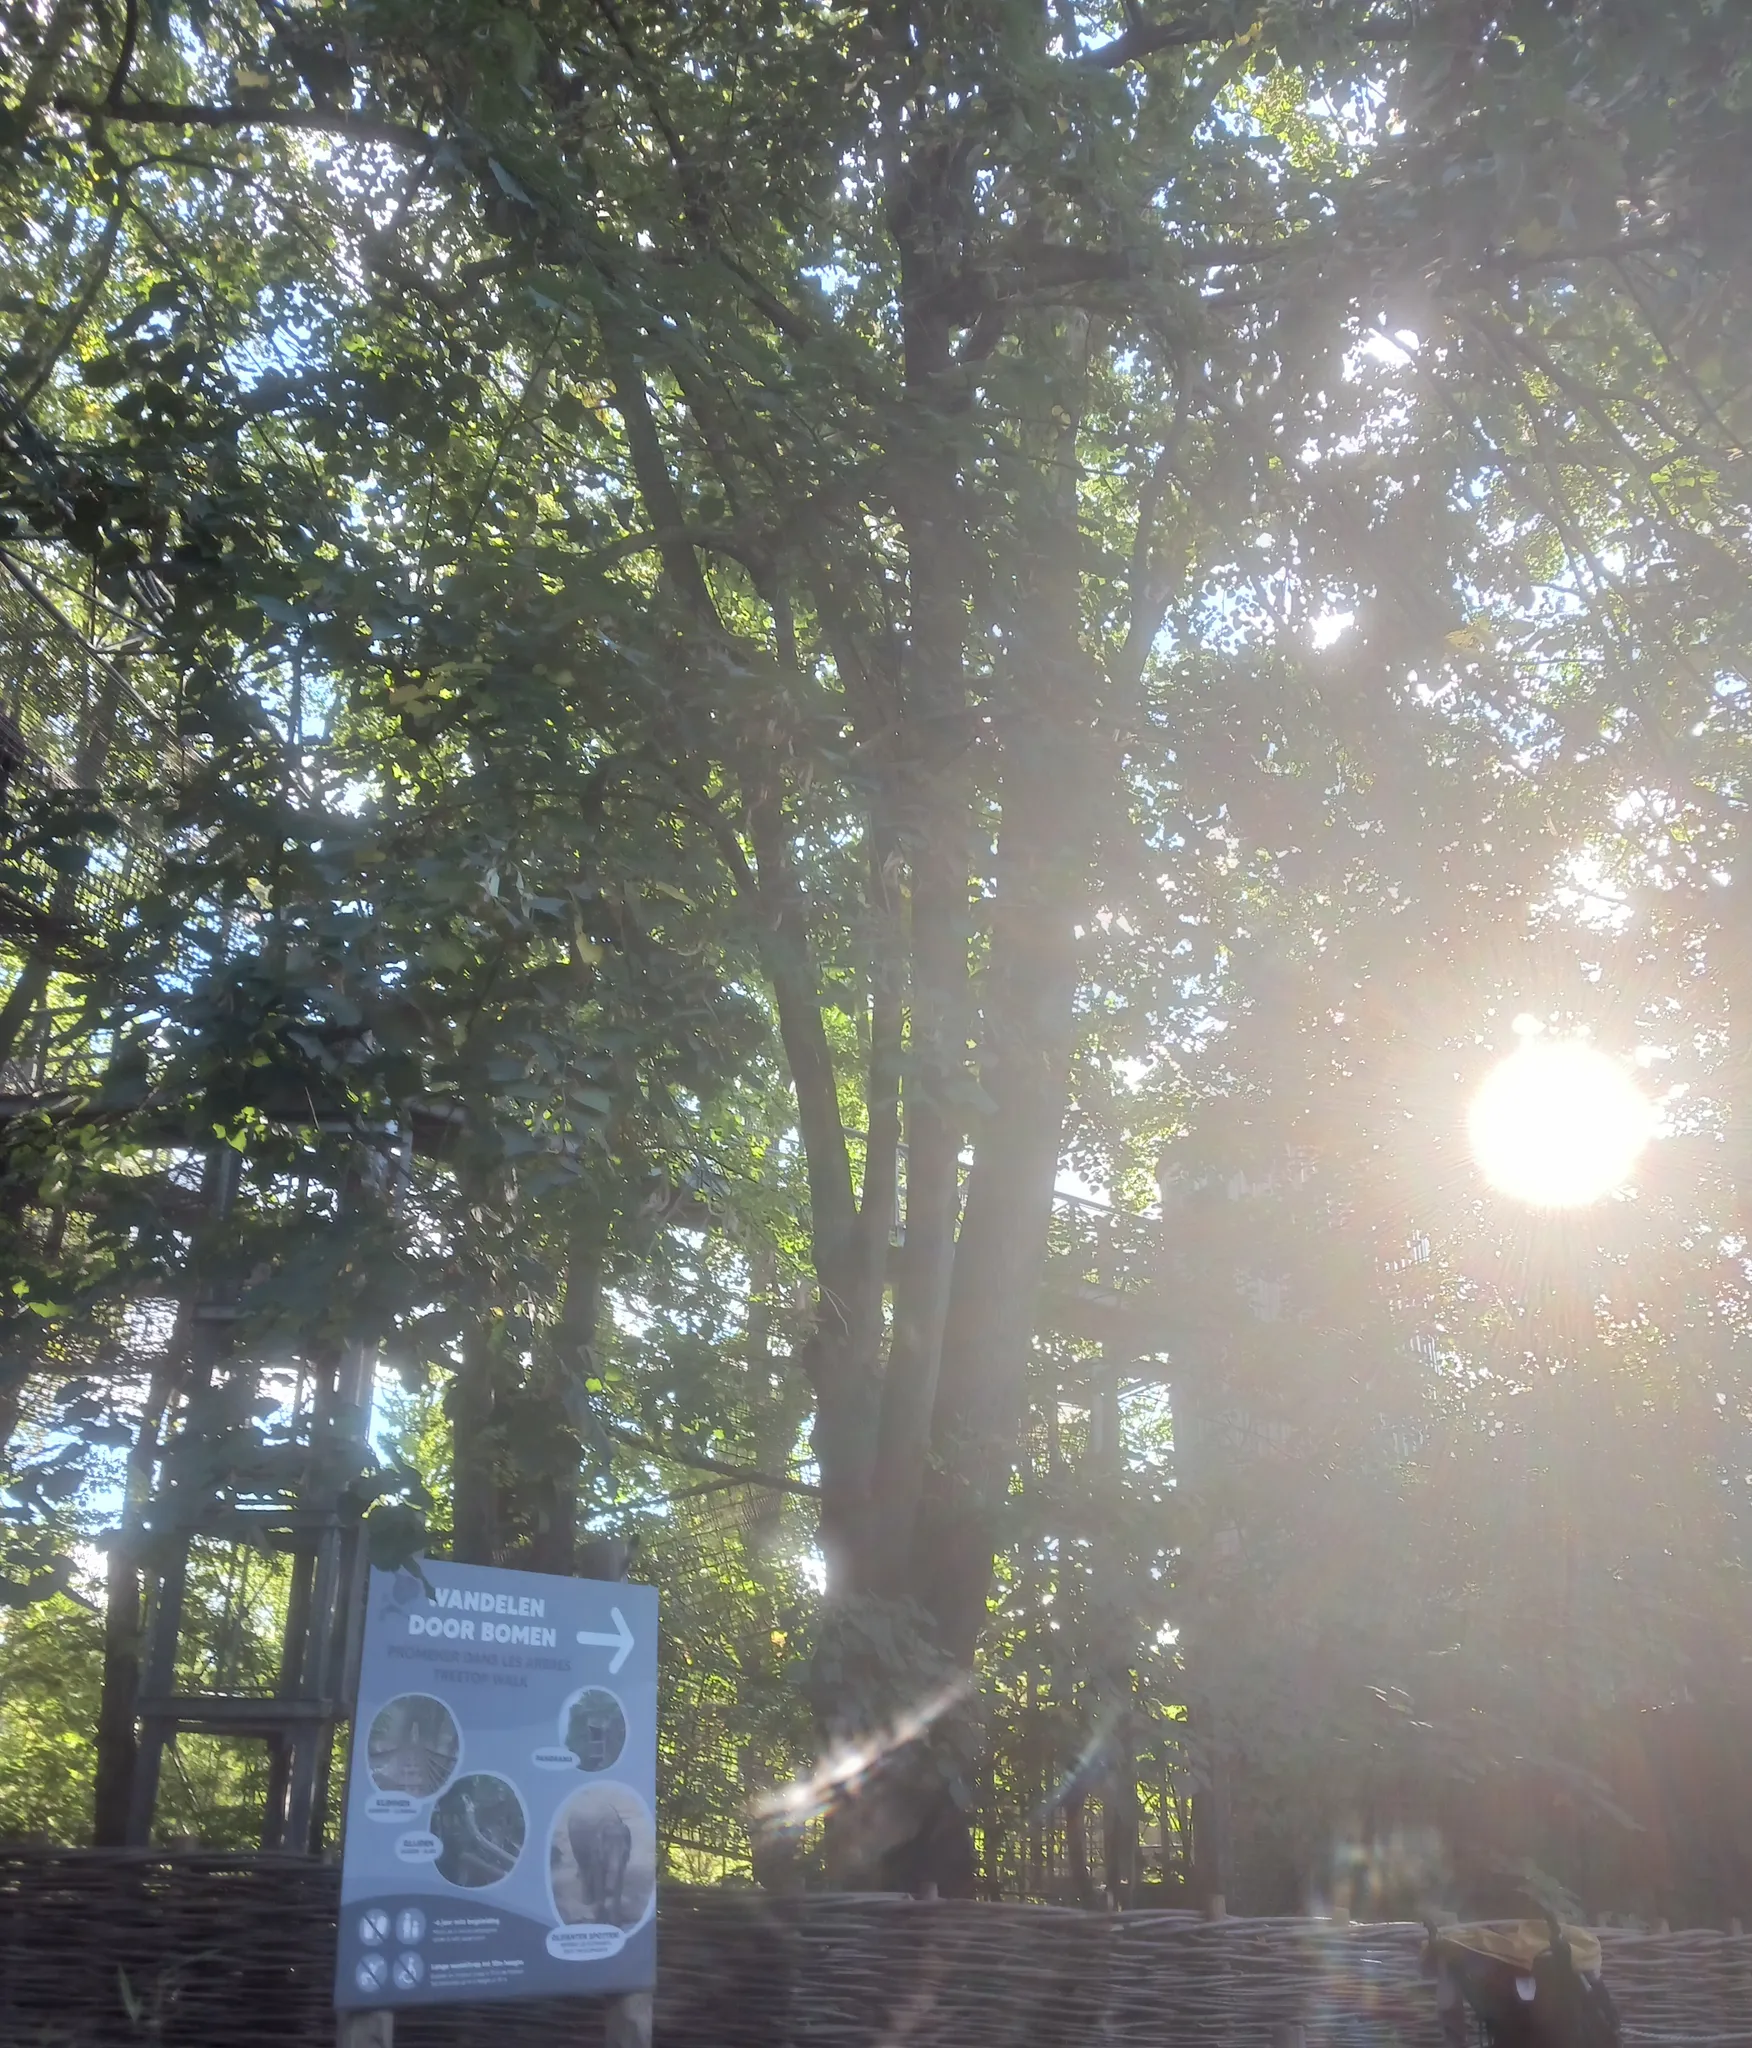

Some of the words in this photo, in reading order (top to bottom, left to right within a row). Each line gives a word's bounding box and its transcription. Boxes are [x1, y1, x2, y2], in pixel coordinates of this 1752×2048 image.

[408, 1614, 475, 1641] DOOR
[481, 1621, 556, 1648] BOMEN
[463, 1650, 499, 1667] DANS
[502, 1653, 522, 1670] LES
[525, 1656, 572, 1672] ARBRES
[433, 1667, 490, 1685] TREETOP
[493, 1673, 528, 1688] WALK
